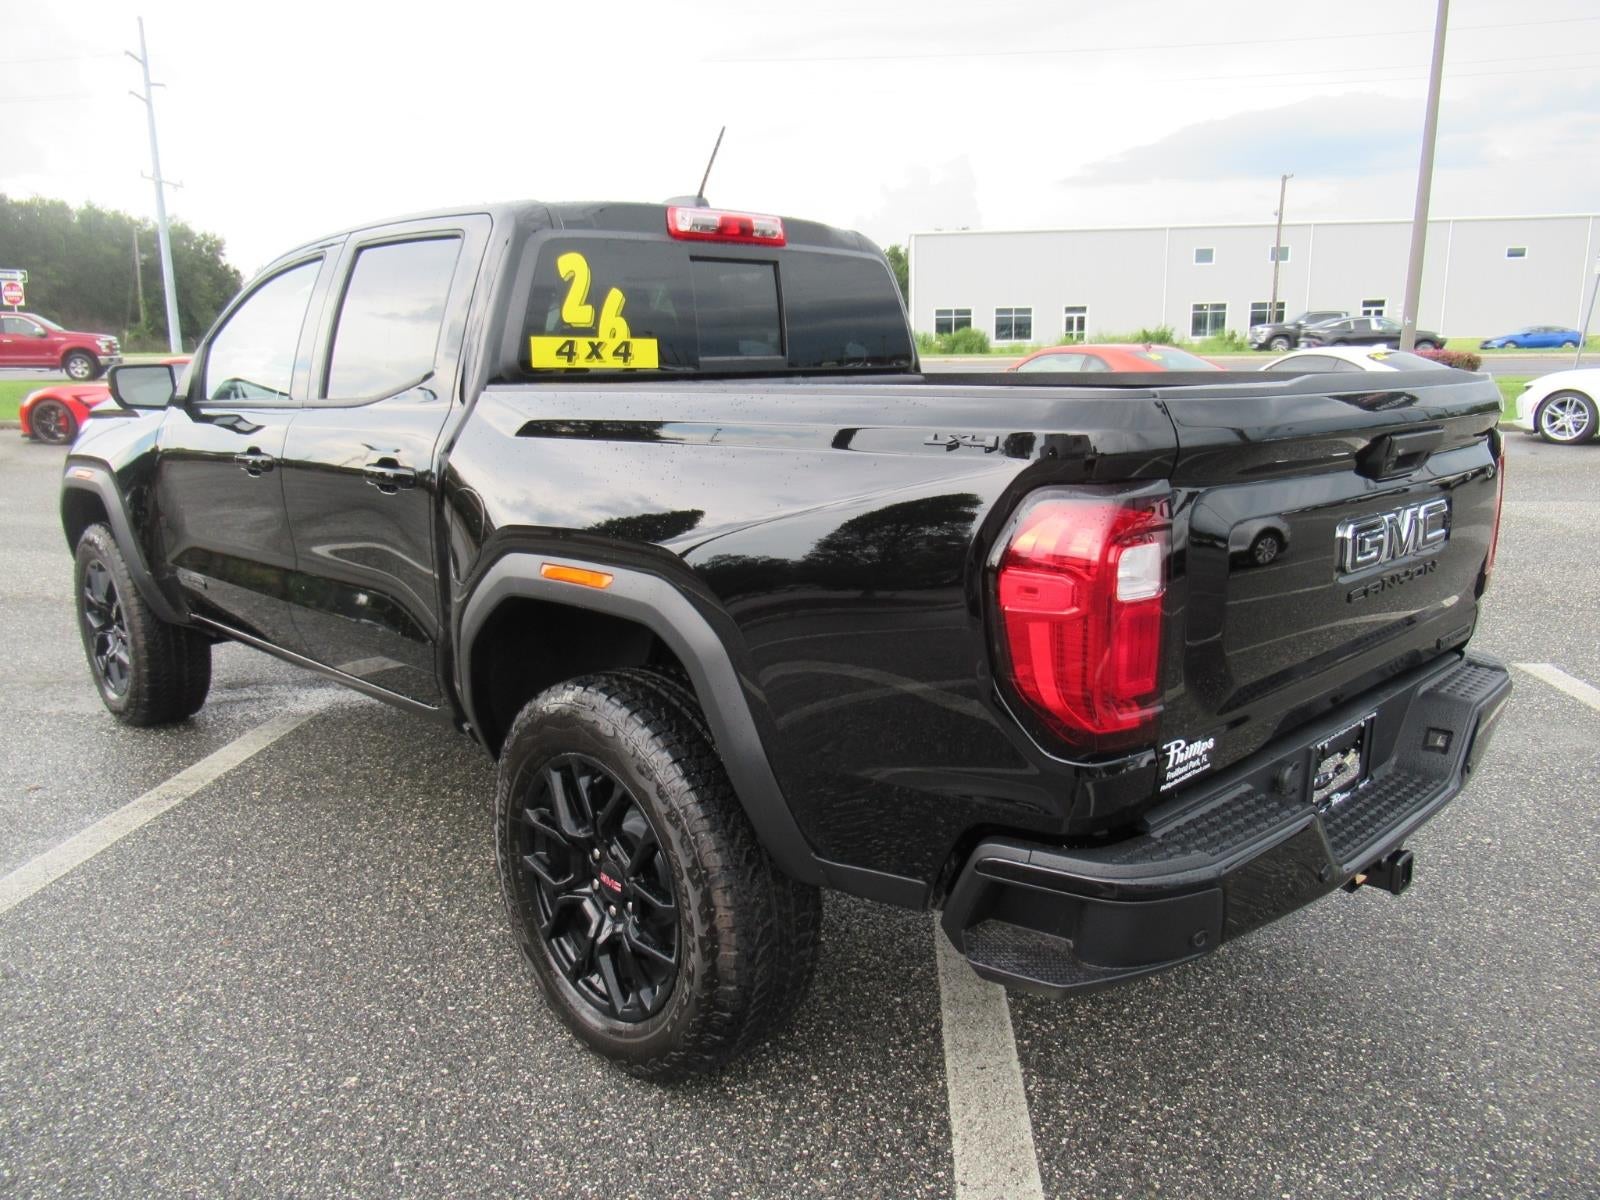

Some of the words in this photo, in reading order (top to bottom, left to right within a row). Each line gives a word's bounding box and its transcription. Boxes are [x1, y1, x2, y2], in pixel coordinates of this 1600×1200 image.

[1335, 498, 1448, 574] GMC
[1346, 559, 1438, 603] CANYON
[1162, 738, 1215, 770] Phillips
